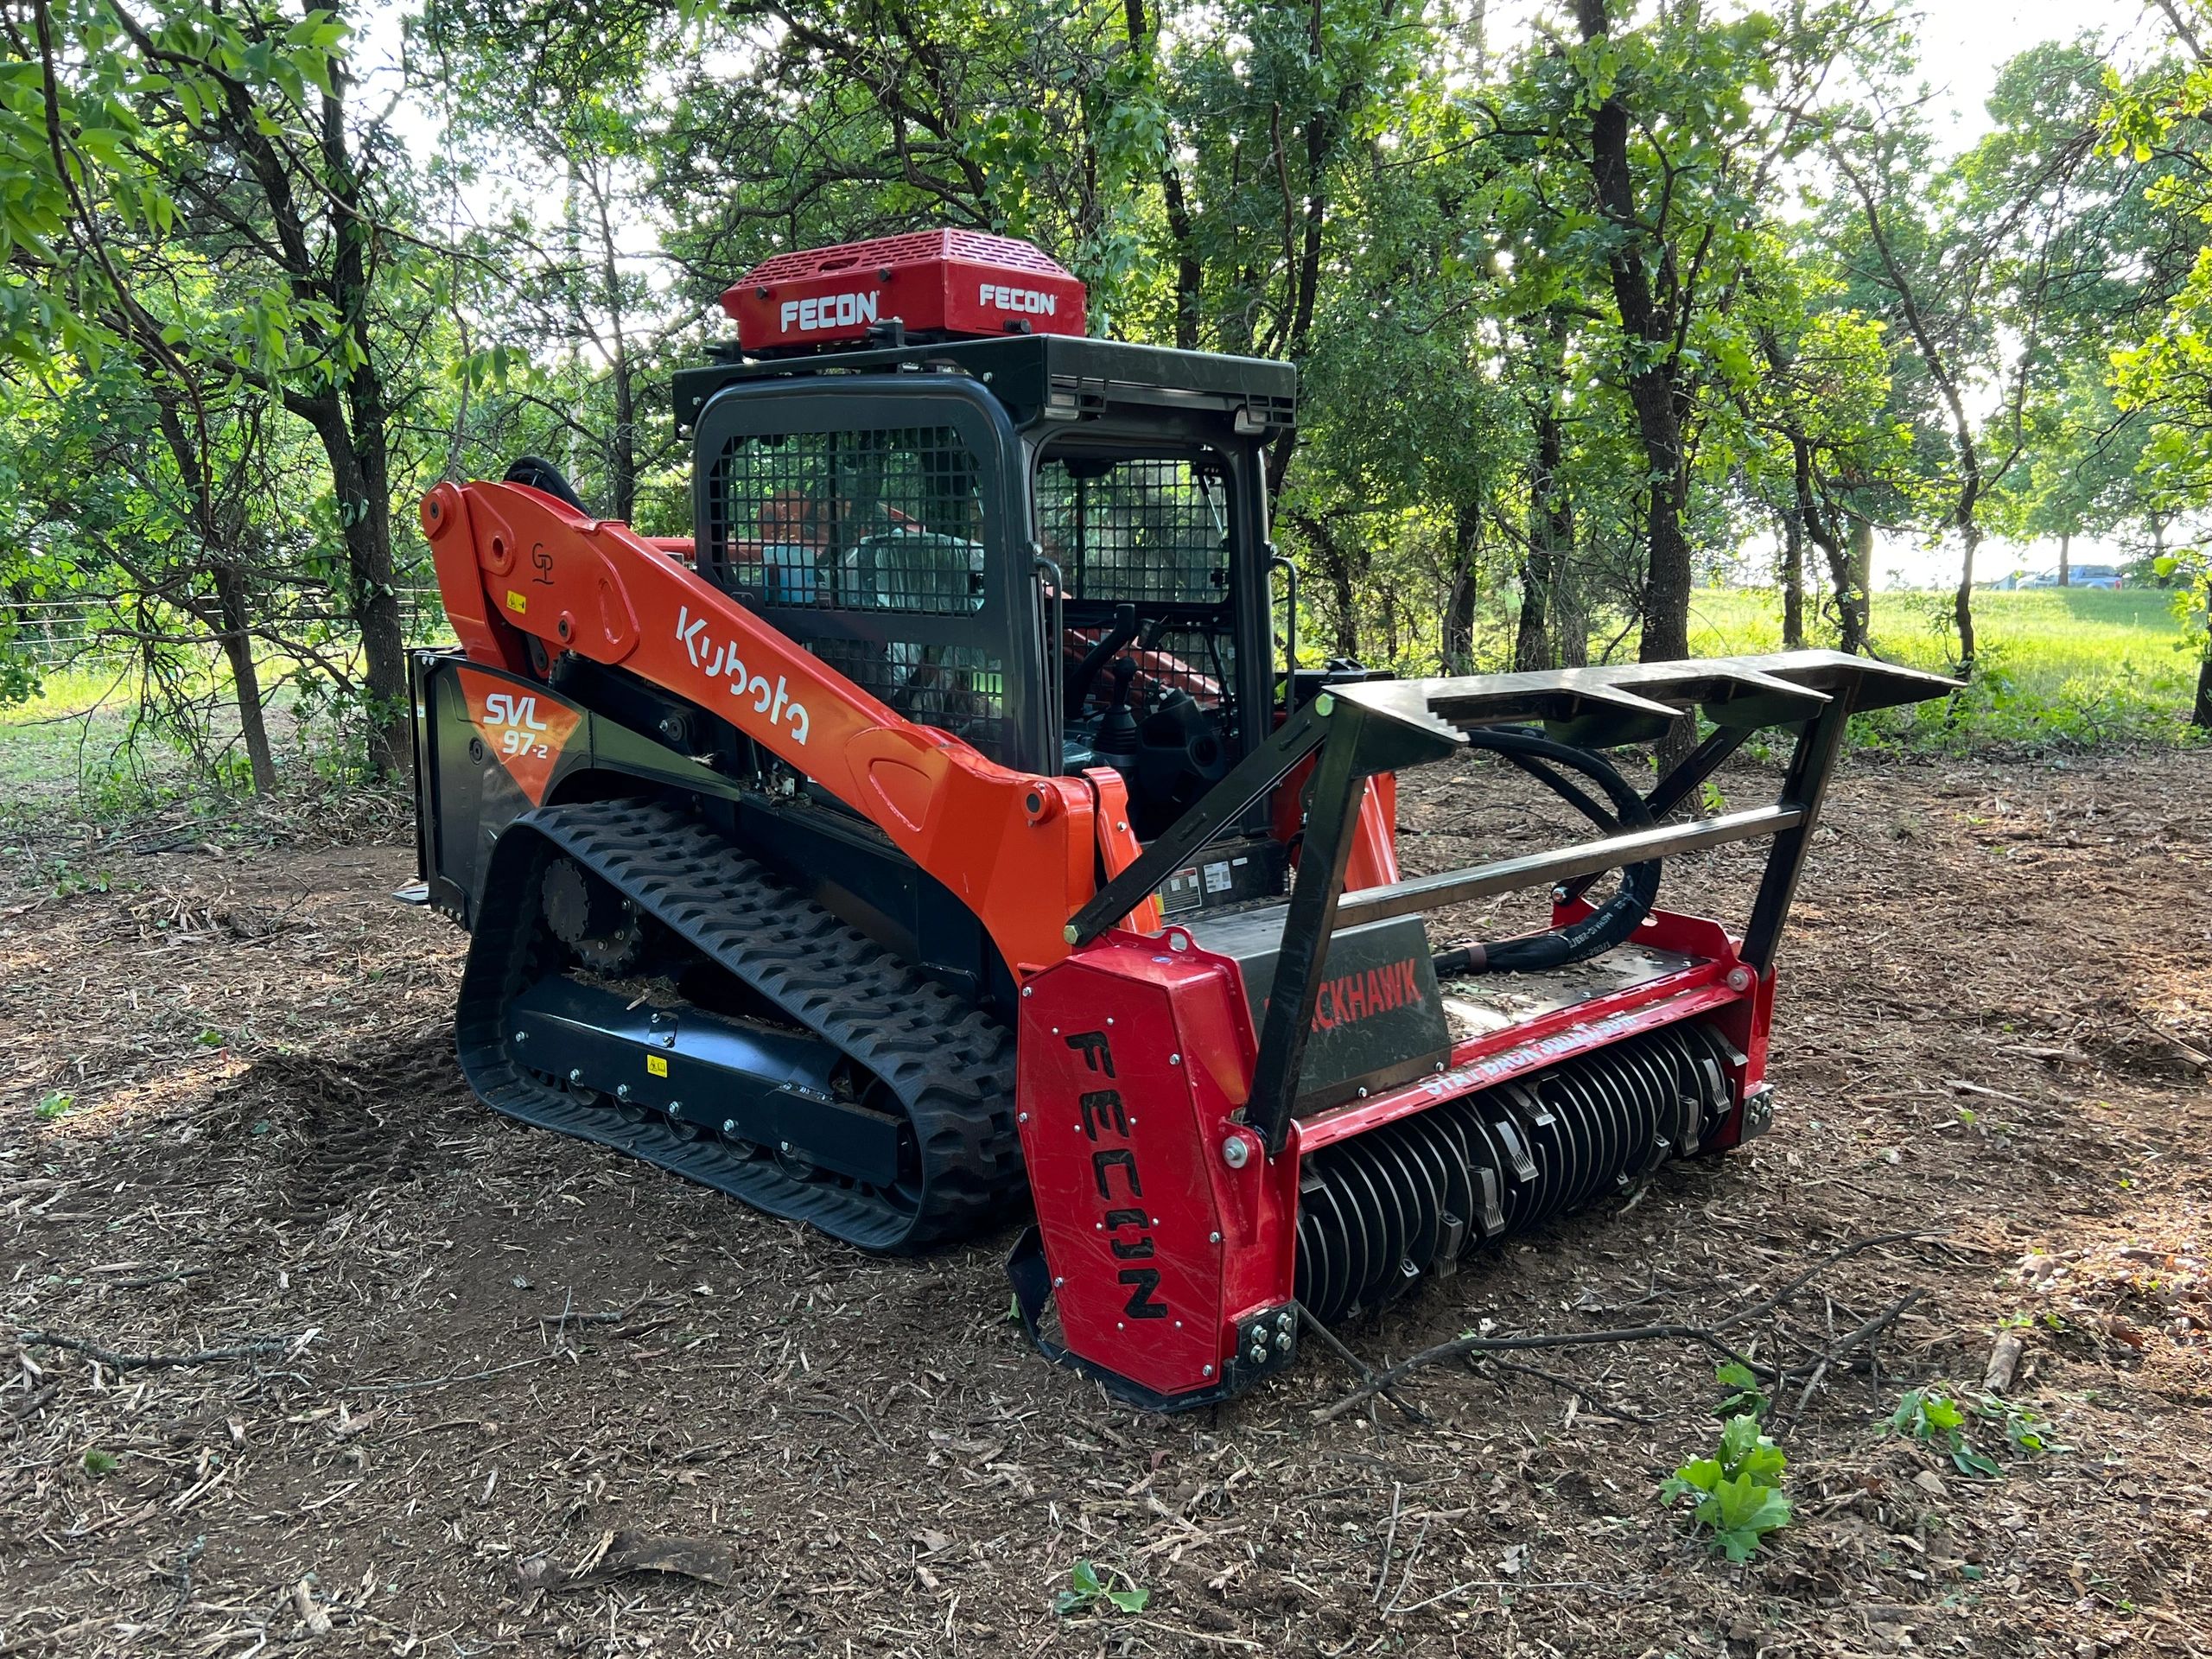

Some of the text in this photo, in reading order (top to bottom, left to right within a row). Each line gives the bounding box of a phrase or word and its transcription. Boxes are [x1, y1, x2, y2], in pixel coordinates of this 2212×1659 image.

[780, 290, 877, 333] FECON
[979, 283, 1055, 316] FECON
[676, 606, 810, 746] Kubota
[483, 694, 547, 731] SVL
[1264, 958, 1422, 1033] CKHAWK
[1064, 1030, 1168, 1319] FECON
